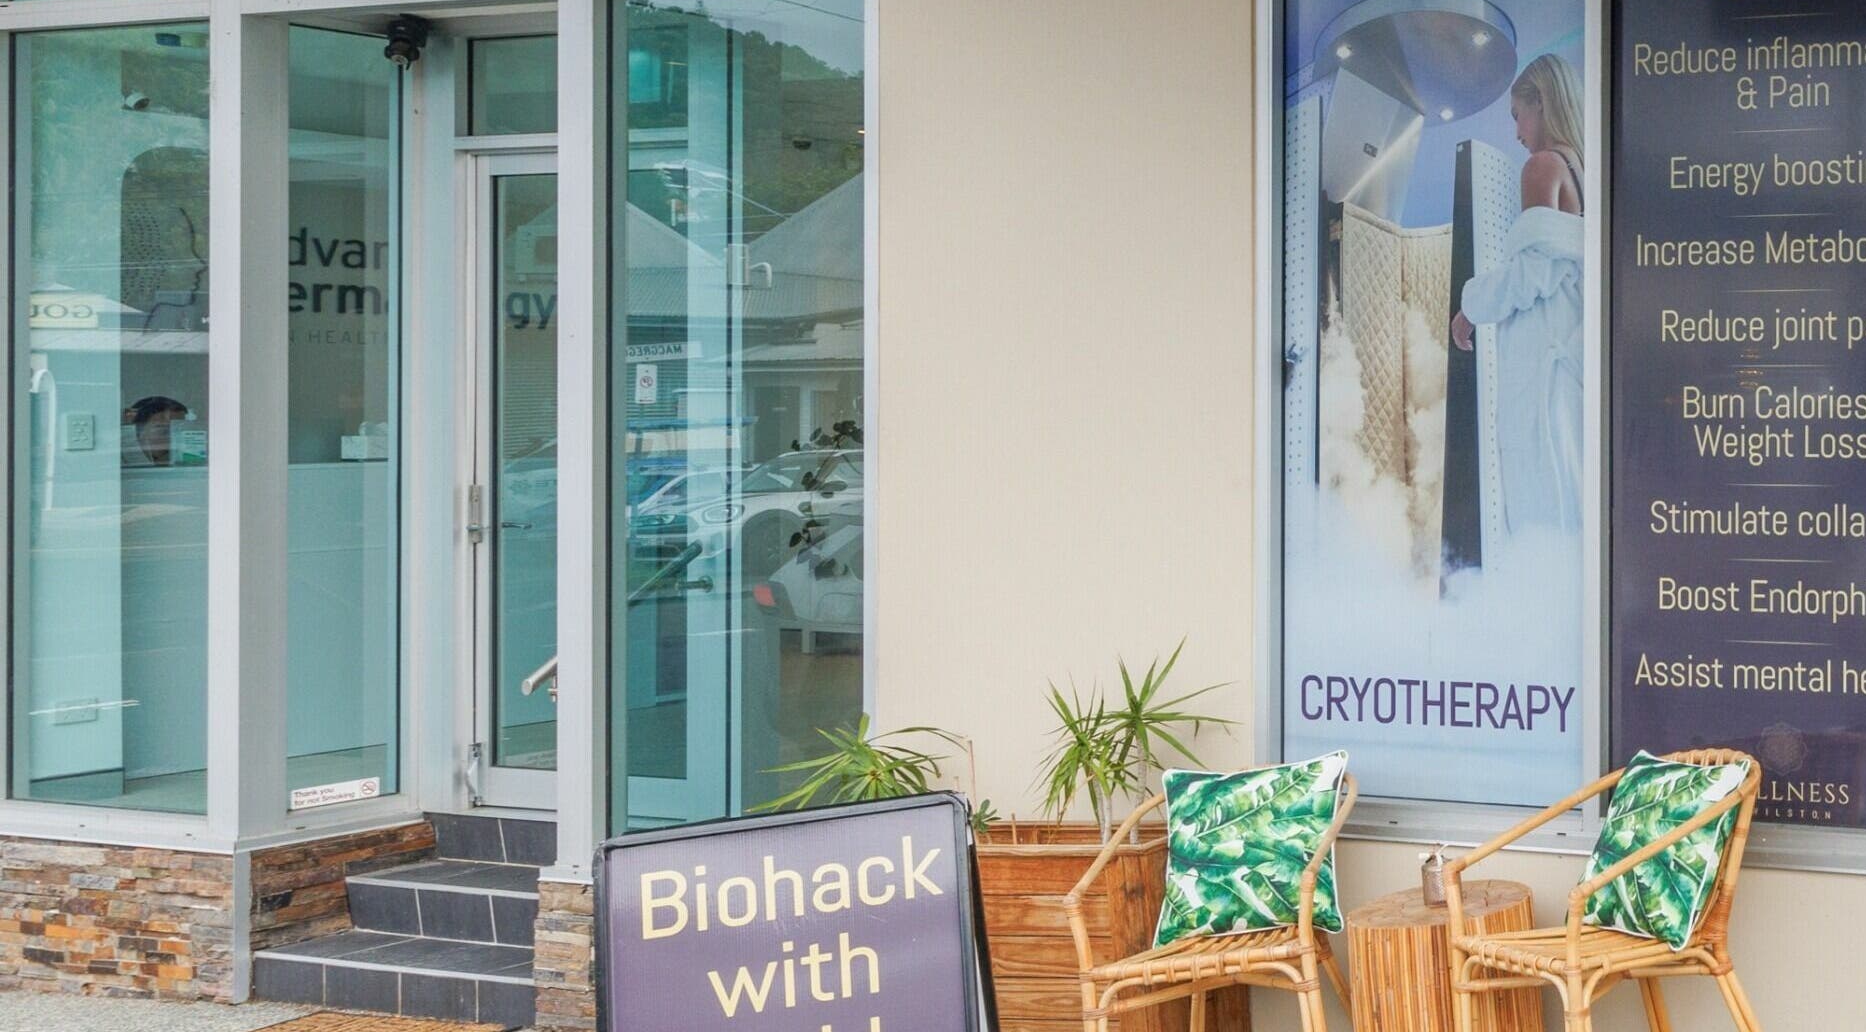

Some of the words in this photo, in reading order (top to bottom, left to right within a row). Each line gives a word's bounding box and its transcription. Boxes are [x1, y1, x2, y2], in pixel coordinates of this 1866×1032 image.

[1634, 41, 1737, 76] Reduce
[1736, 76, 1757, 110] &
[1769, 74, 1830, 108] Pain
[1670, 156, 1765, 196] Energy
[1636, 234, 1755, 266] Increase
[289, 280, 388, 315] erm
[308, 329, 388, 346] HEALT
[1660, 309, 1764, 343] Reduce
[1772, 308, 1837, 350] joint
[1683, 386, 1745, 419] Burn
[1693, 424, 1794, 466] Weight
[1650, 500, 1788, 536] Stimulate
[1658, 577, 1740, 612] Boost
[1635, 653, 1723, 689] Assist
[1733, 659, 1832, 693] mental
[1300, 674, 1576, 733] CRYOTHERAPY
[1757, 781, 1850, 805] LLNESS
[640, 835, 945, 941] Biohack
[707, 932, 880, 1018] with
